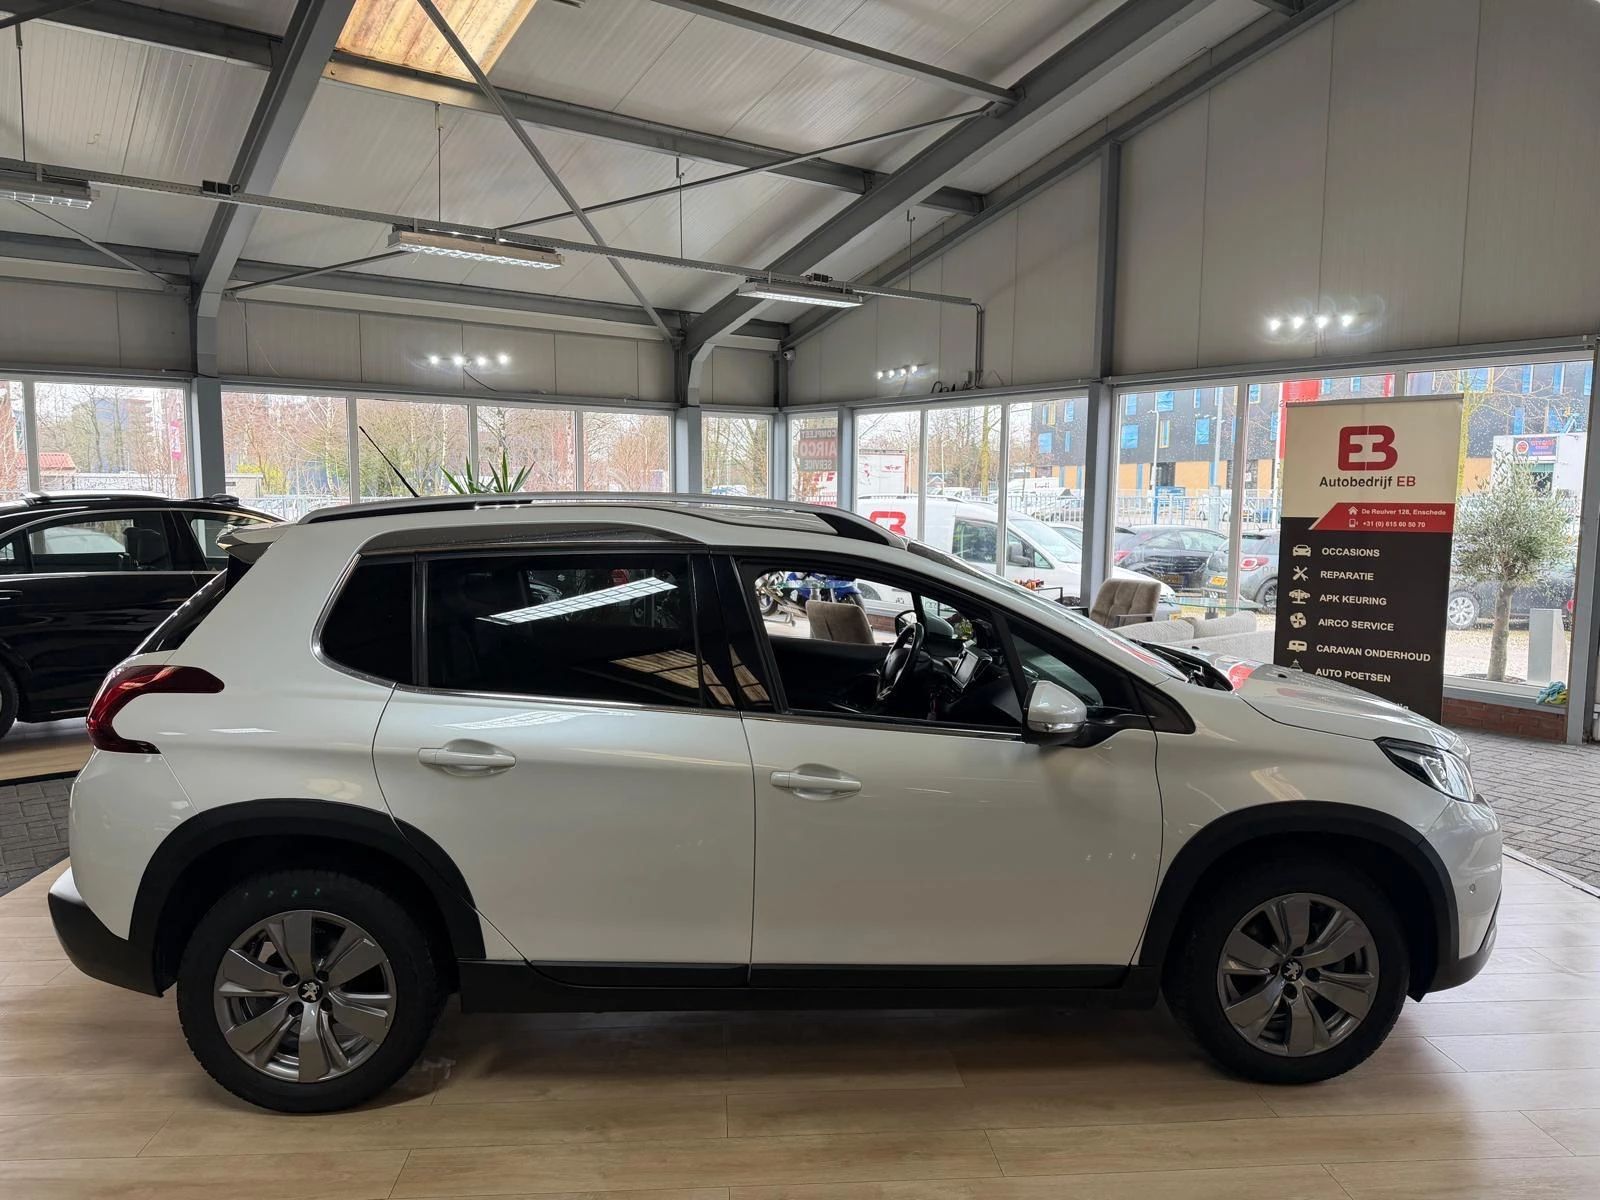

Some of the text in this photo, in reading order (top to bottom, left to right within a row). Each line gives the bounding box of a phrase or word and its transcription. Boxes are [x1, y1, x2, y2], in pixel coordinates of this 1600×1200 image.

[1338, 425, 1398, 471] EB
[1319, 475, 1416, 490] Autobedrijf EB
[1321, 547, 1380, 557] OCCASIONS
[1320, 570, 1375, 581] REPARATIE
[1319, 594, 1387, 606] APK KEURING
[1318, 618, 1394, 632] AIRCO SERVICE
[1316, 644, 1431, 662] CARAVAN ONDERHOUD
[1315, 668, 1391, 683] AUTO POETSEN
